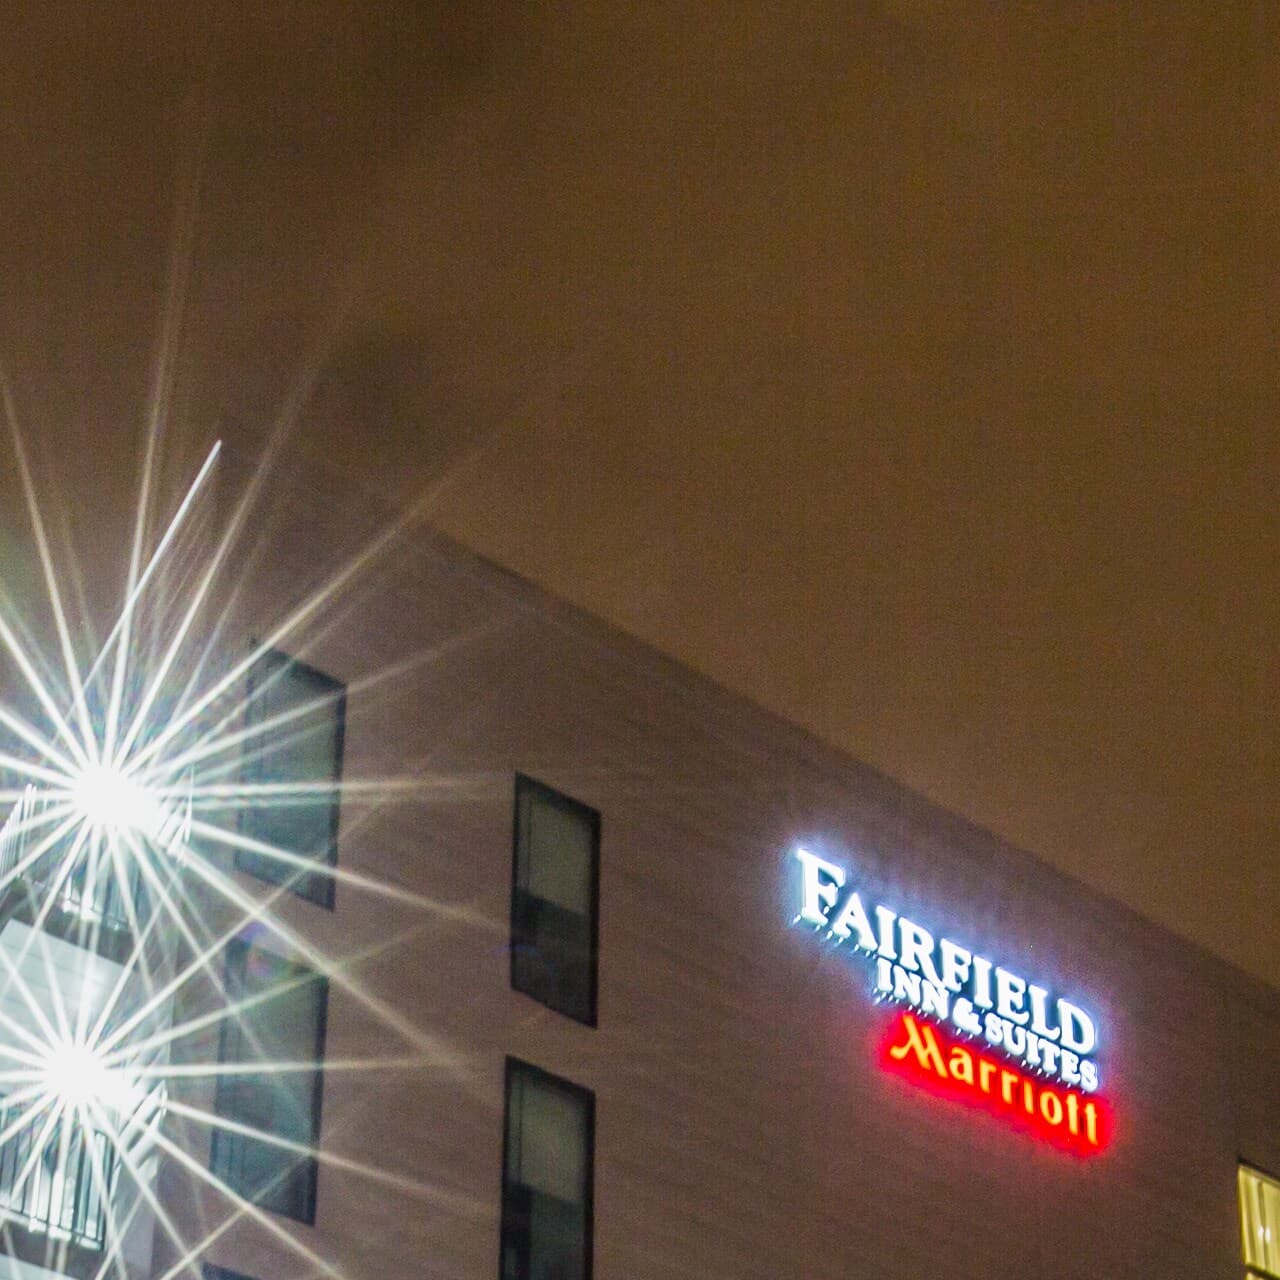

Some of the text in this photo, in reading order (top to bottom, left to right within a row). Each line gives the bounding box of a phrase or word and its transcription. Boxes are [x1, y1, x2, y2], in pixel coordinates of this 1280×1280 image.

[797, 848, 1096, 1055] FAIRFIELD
[876, 957, 1099, 1093] INN & SUITES
[890, 1013, 1098, 1146] Marriott
